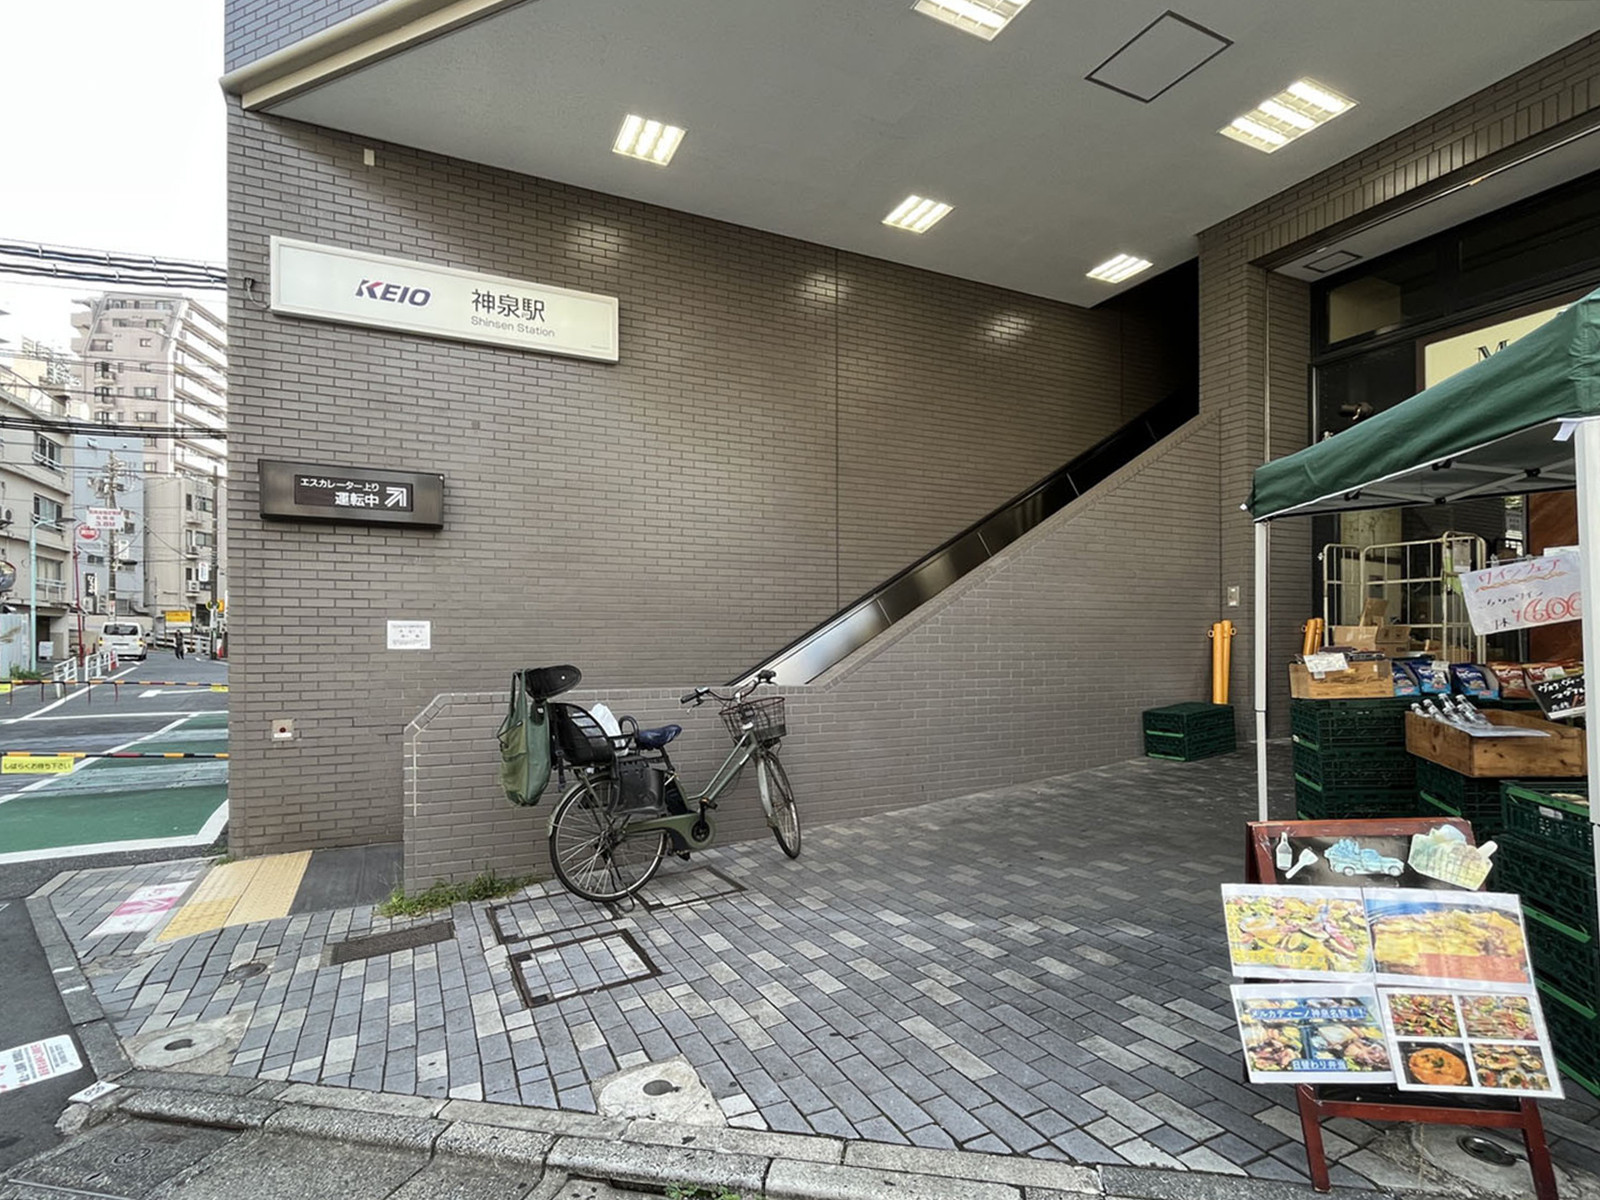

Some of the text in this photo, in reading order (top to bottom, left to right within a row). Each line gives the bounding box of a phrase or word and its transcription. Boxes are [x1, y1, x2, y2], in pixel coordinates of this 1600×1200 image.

[355, 280, 431, 307] KEIO
[471, 289, 545, 322] 神泉駅
[471, 316, 555, 337] Shinsen Station
[301, 478, 380, 492] エスカレーター上り
[335, 492, 379, 507] 運転中
